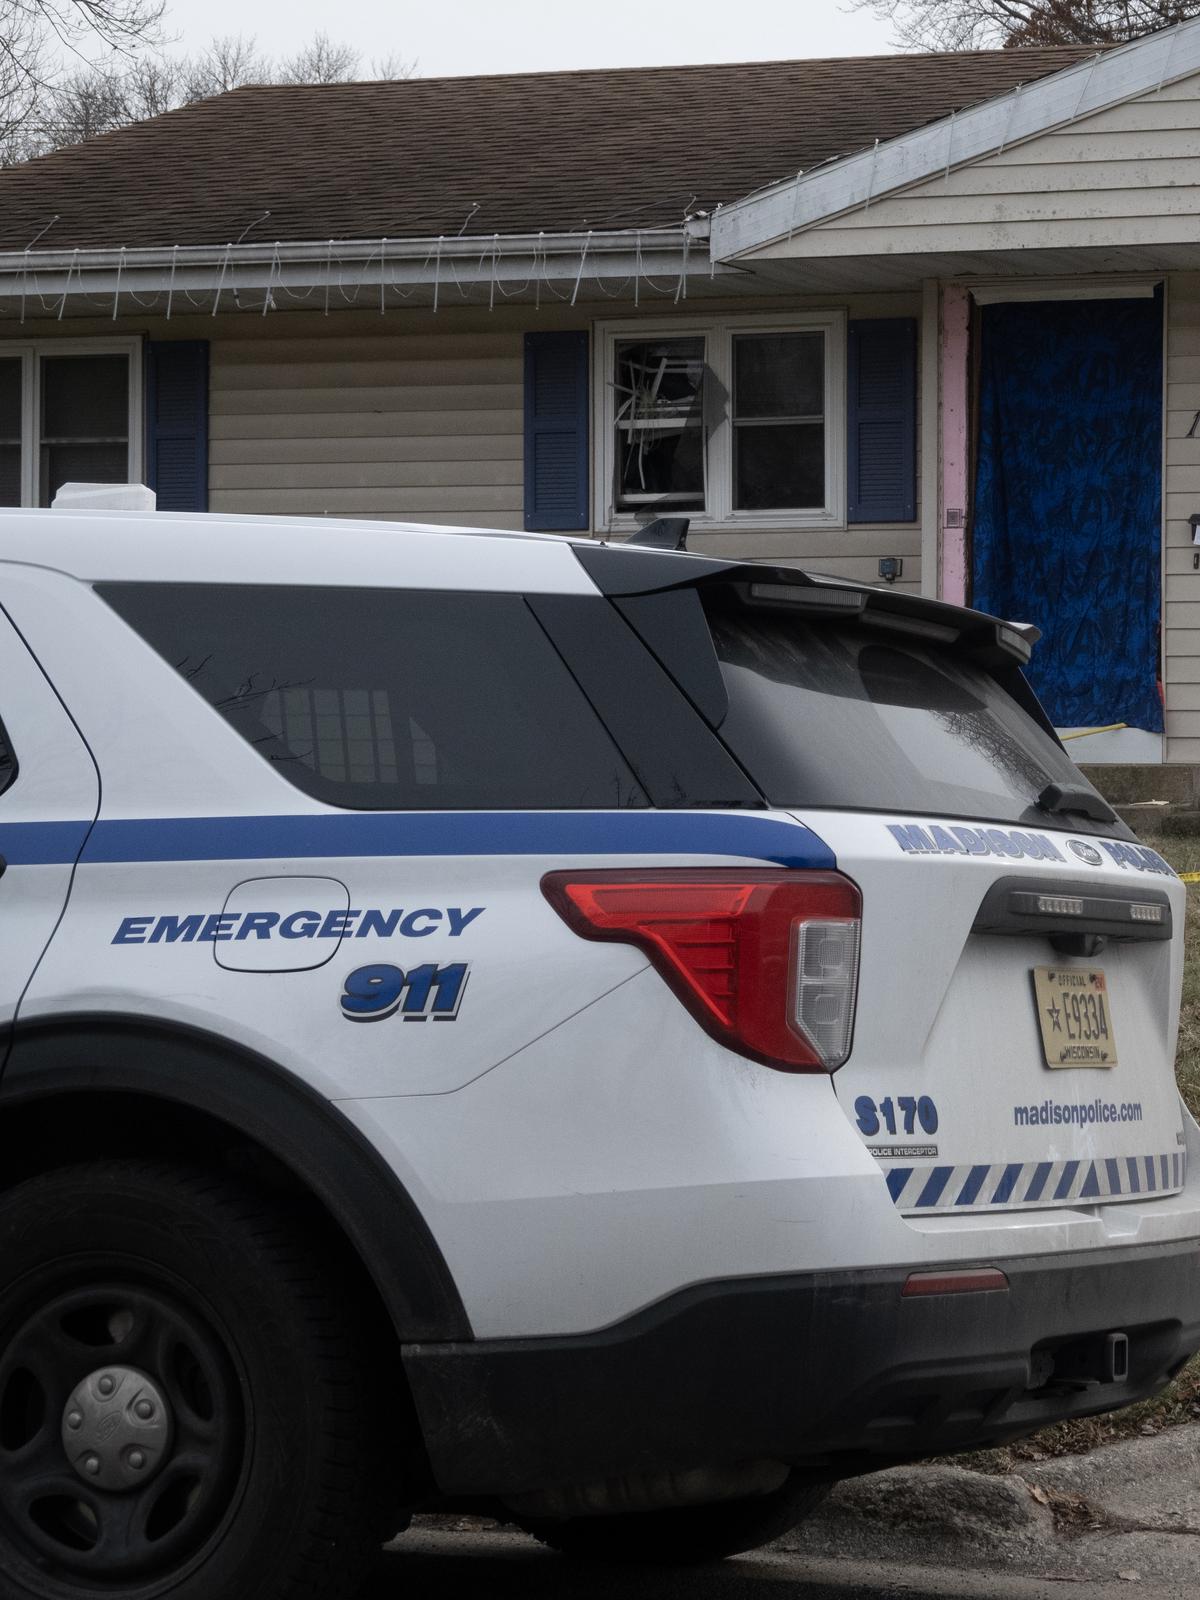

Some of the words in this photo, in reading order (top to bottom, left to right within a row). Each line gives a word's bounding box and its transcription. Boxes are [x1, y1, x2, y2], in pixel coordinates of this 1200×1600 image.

[886, 825, 1067, 862] MADISON
[110, 907, 486, 944] EMERGENCY
[340, 963, 471, 1022] 911
[1058, 974, 1086, 987] OFFICIAL
[1064, 1046, 1100, 1058] WISCONSIN
[854, 1095, 938, 1136] S170
[1014, 1099, 1142, 1128] madisonpolice.com
[893, 1147, 937, 1156] INTERCEPTOR
